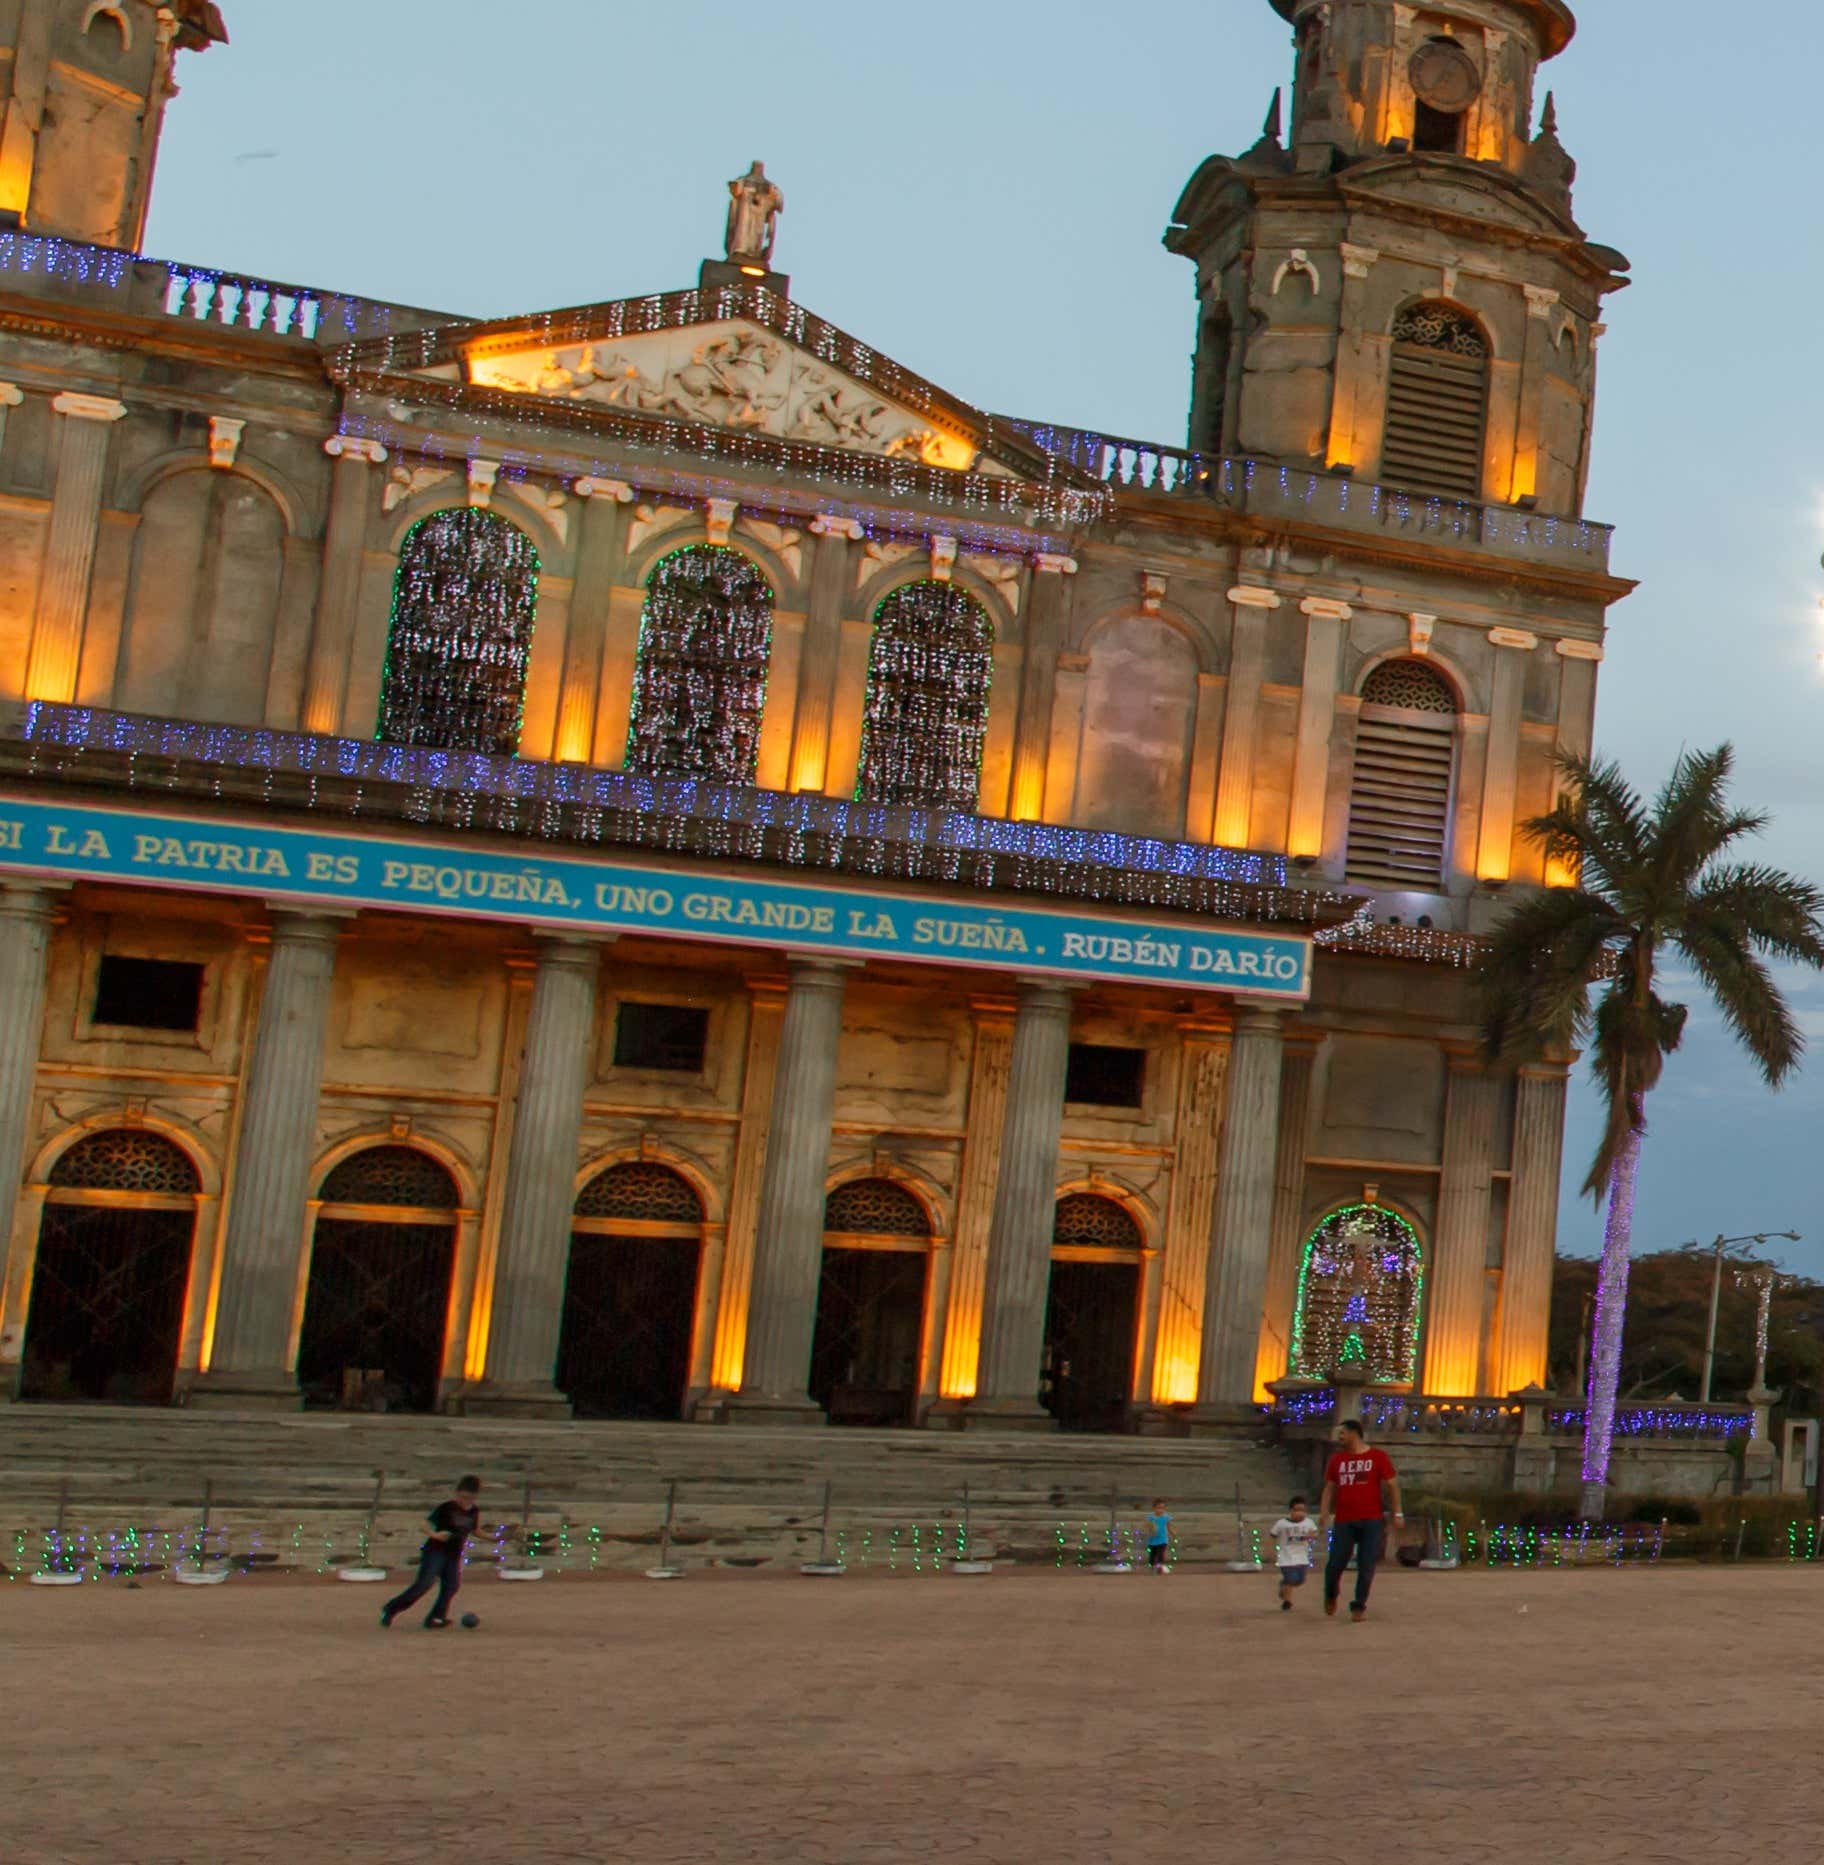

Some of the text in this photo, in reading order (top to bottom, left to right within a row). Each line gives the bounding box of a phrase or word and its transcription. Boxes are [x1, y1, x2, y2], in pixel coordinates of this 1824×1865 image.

[45, 825, 112, 860] LA
[132, 834, 290, 879] PATRIA
[307, 853, 359, 884] ES
[381, 860, 581, 910] PEQUEÑA,
[594, 884, 672, 919] UNO
[683, 891, 834, 934] GRANDE
[847, 910, 899, 941] LA
[1061, 933, 1179, 969] RUBÉN
[1190, 943, 1298, 981] DARÍO
[1339, 1460, 1373, 1472] AERO
